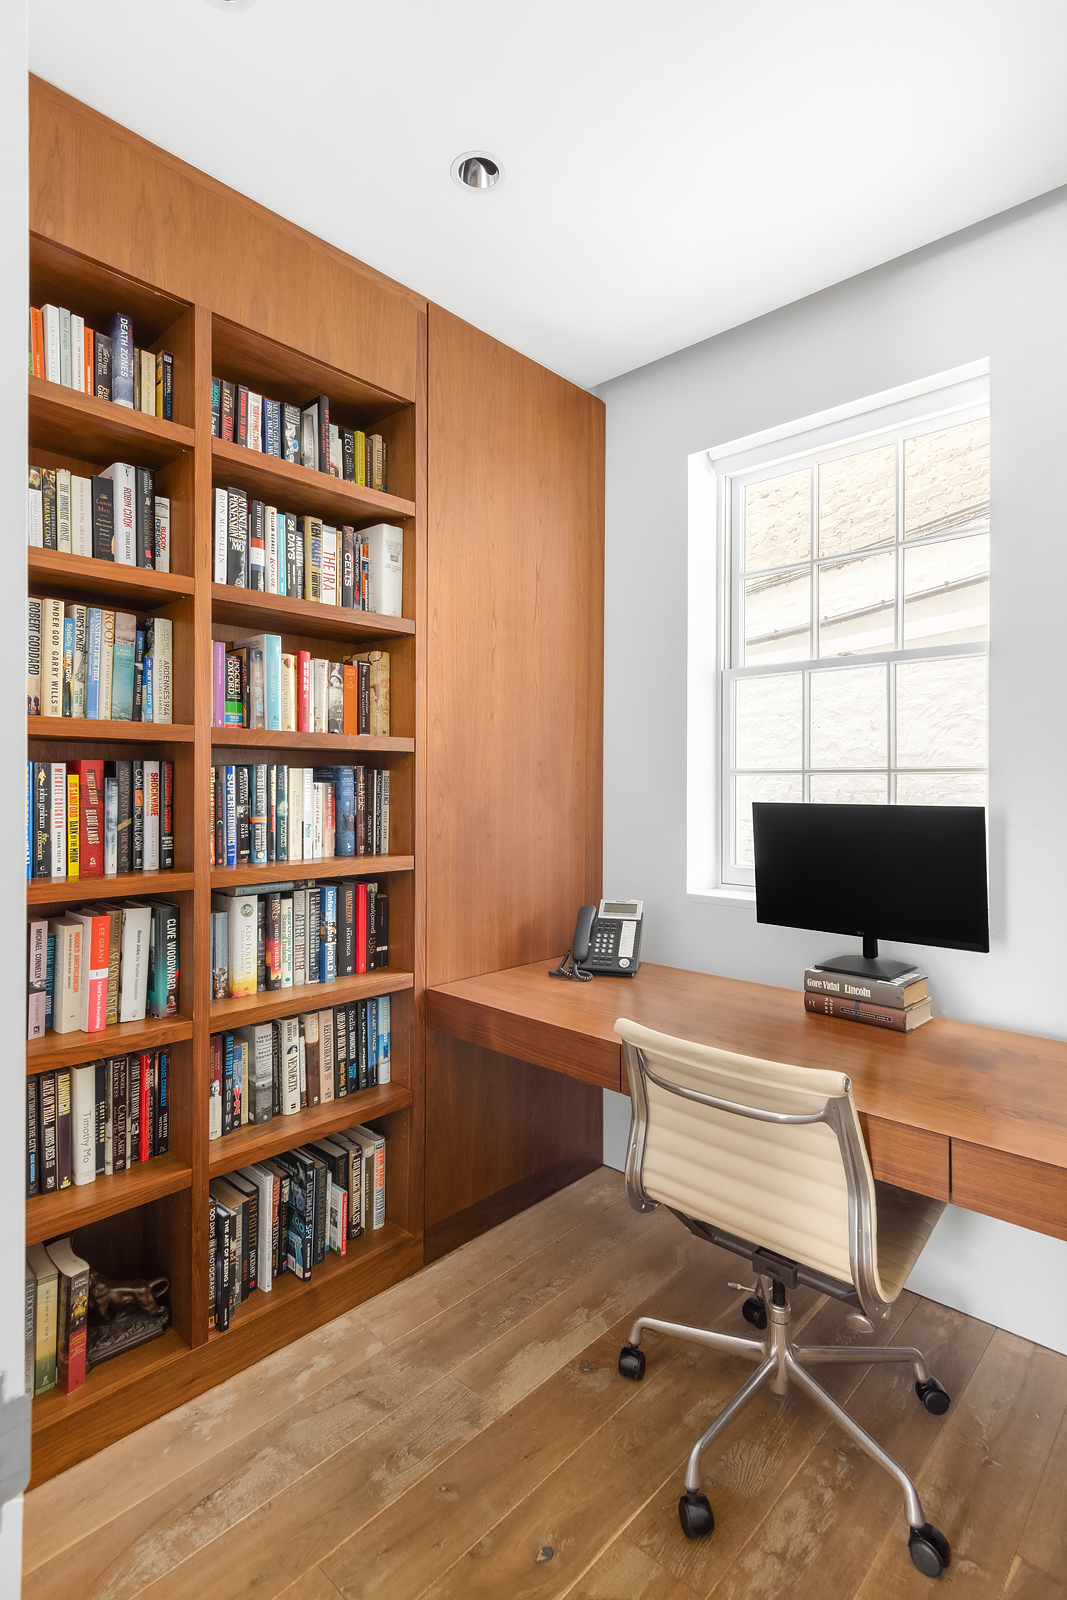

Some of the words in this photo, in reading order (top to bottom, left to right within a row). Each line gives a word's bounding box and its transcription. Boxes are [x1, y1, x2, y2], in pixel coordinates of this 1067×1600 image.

[120, 318, 128, 346] DEATH
[120, 347, 128, 378] ZONES
[240, 417, 246, 425] TO
[344, 433, 352, 453] ECO
[123, 486, 132, 507] ROBIN
[238, 495, 247, 509] AN
[123, 508, 132, 529] COOK
[228, 493, 239, 538] POSSESSION
[238, 511, 247, 540] INSULAR
[287, 519, 295, 531] 24
[311, 521, 321, 538] KEN
[287, 533, 295, 561] DAYS
[311, 538, 321, 569] FOLLETT
[323, 551, 336, 571] THE
[344, 552, 352, 587] CELTS
[311, 571, 319, 599] FORTUNE
[323, 572, 336, 591] IRA
[28, 601, 40, 635] ROBERT
[52, 601, 60, 628] UNDER
[76, 608, 84, 628] LIAR'S
[52, 630, 60, 646] GOD
[65, 623, 73, 647] StyleCity
[76, 627, 84, 652] POKER
[104, 612, 114, 648] KOOP
[28, 635, 40, 676] GODDARD
[51, 651, 59, 678] GARRY
[227, 660, 235, 695] OXFORD
[51, 680, 59, 705] WILLS
[54, 768, 63, 795] MICHAEL
[134, 768, 143, 790] CABAL
[256, 765, 265, 788] SCOTT
[37, 787, 48, 803] john
[150, 772, 159, 817] SHOCKWAVE
[256, 789, 265, 816] TUROW
[37, 803, 47, 829] grisham
[54, 797, 63, 829] CRICHTON
[134, 806, 143, 831] MICHAEL
[295, 914, 305, 938] AFTER
[326, 890, 334, 941] Unforgettable
[35, 928, 43, 951] MICHAEL
[166, 918, 176, 940] CLIVE
[35, 953, 43, 979] CONNELLY
[166, 941, 176, 990] WOODWARD
[295, 944, 305, 971] HITLER
[326, 944, 334, 971] WORLD
[807, 978, 823, 989] Gore
[822, 980, 840, 992] Vidal
[844, 984, 871, 998] Lincoln
[324, 1024, 332, 1072] RECONSTRUCTION
[225, 1053, 233, 1076] BOWDEN
[288, 1054, 298, 1093] VENDETTA
[28, 1083, 36, 1100] DARK
[28, 1099, 36, 1119] TIMES
[117, 1104, 126, 1131] CALEB
[28, 1125, 36, 1138] THE
[81, 1110, 92, 1147] Timothy
[28, 1138, 36, 1153] CITY
[117, 1131, 126, 1156] CARR
[82, 1149, 91, 1164] Mo
[272, 1181, 280, 1206] WOLF
[318, 1169, 326, 1199] ROBERT
[208, 1207, 216, 1221] 100
[249, 1193, 257, 1213] KEN
[305, 1181, 313, 1222] ULTIMATE
[208, 1221, 216, 1238] DAYS
[318, 1200, 326, 1238] GODDARD
[375, 1210, 384, 1225] JOHN
[208, 1238, 216, 1247] IN
[249, 1214, 257, 1247] FOLLETT
[272, 1216, 280, 1250] STRING
[305, 1224, 313, 1239] SPY
[223, 1248, 229, 1258] OF
[208, 1249, 216, 1301] PHOTOGRAPHS
